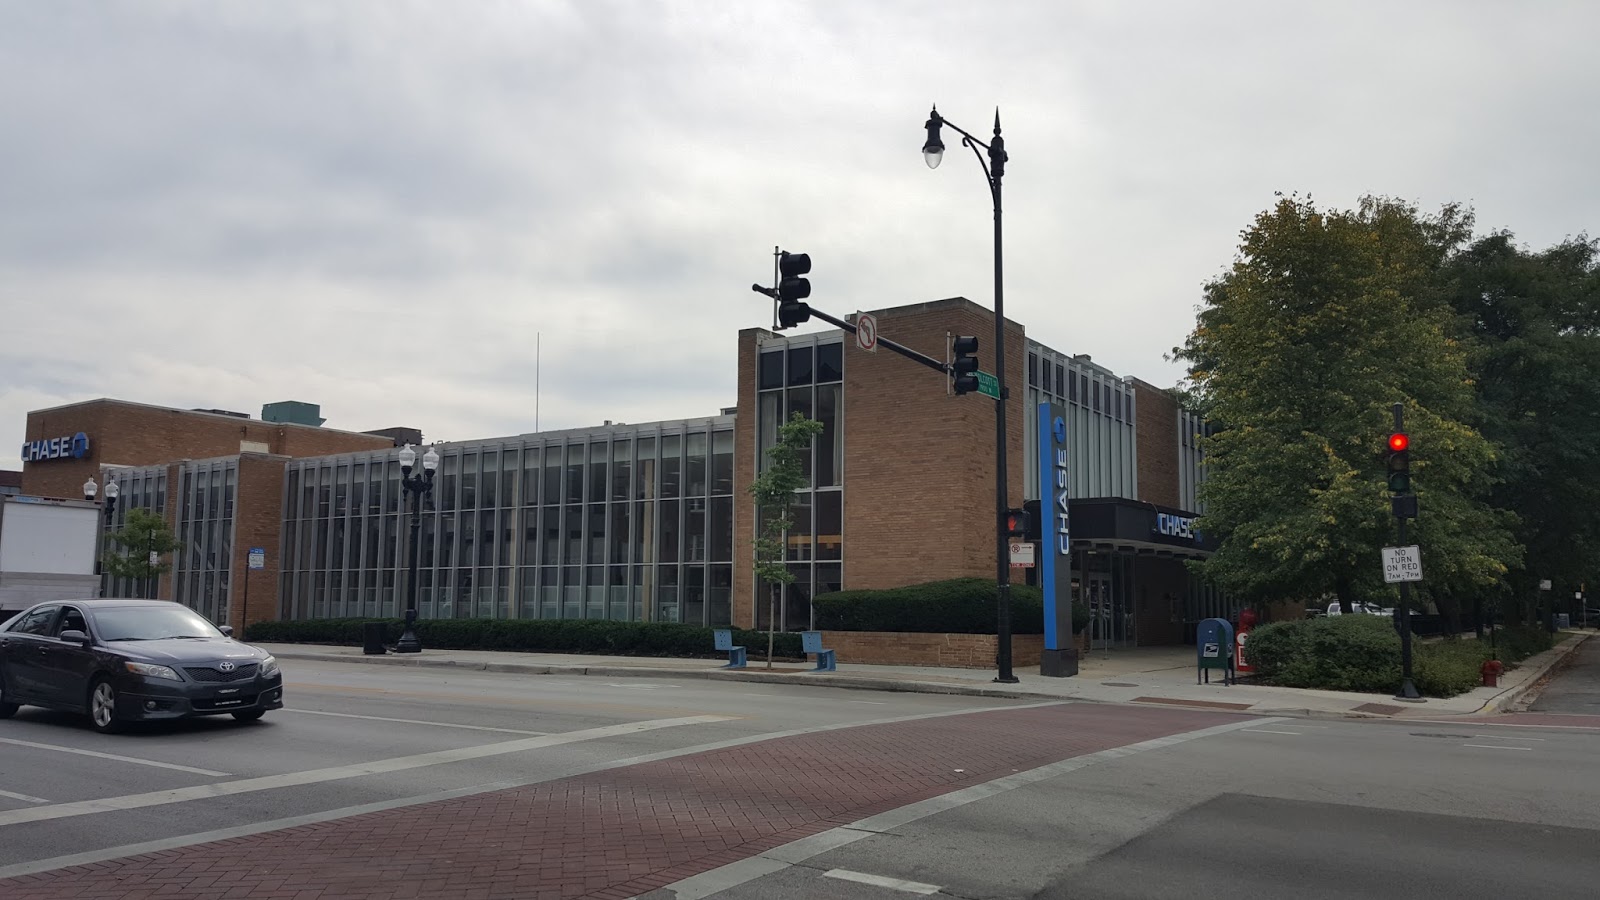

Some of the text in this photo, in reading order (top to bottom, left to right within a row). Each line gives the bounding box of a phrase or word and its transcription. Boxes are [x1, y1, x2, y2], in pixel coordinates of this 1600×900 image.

[21, 436, 70, 462] CHASE
[1057, 448, 1069, 555] CHASE
[1158, 513, 1194, 539] CHASE
[1386, 562, 1418, 572] ON RED
[1390, 556, 1413, 564] TURN
